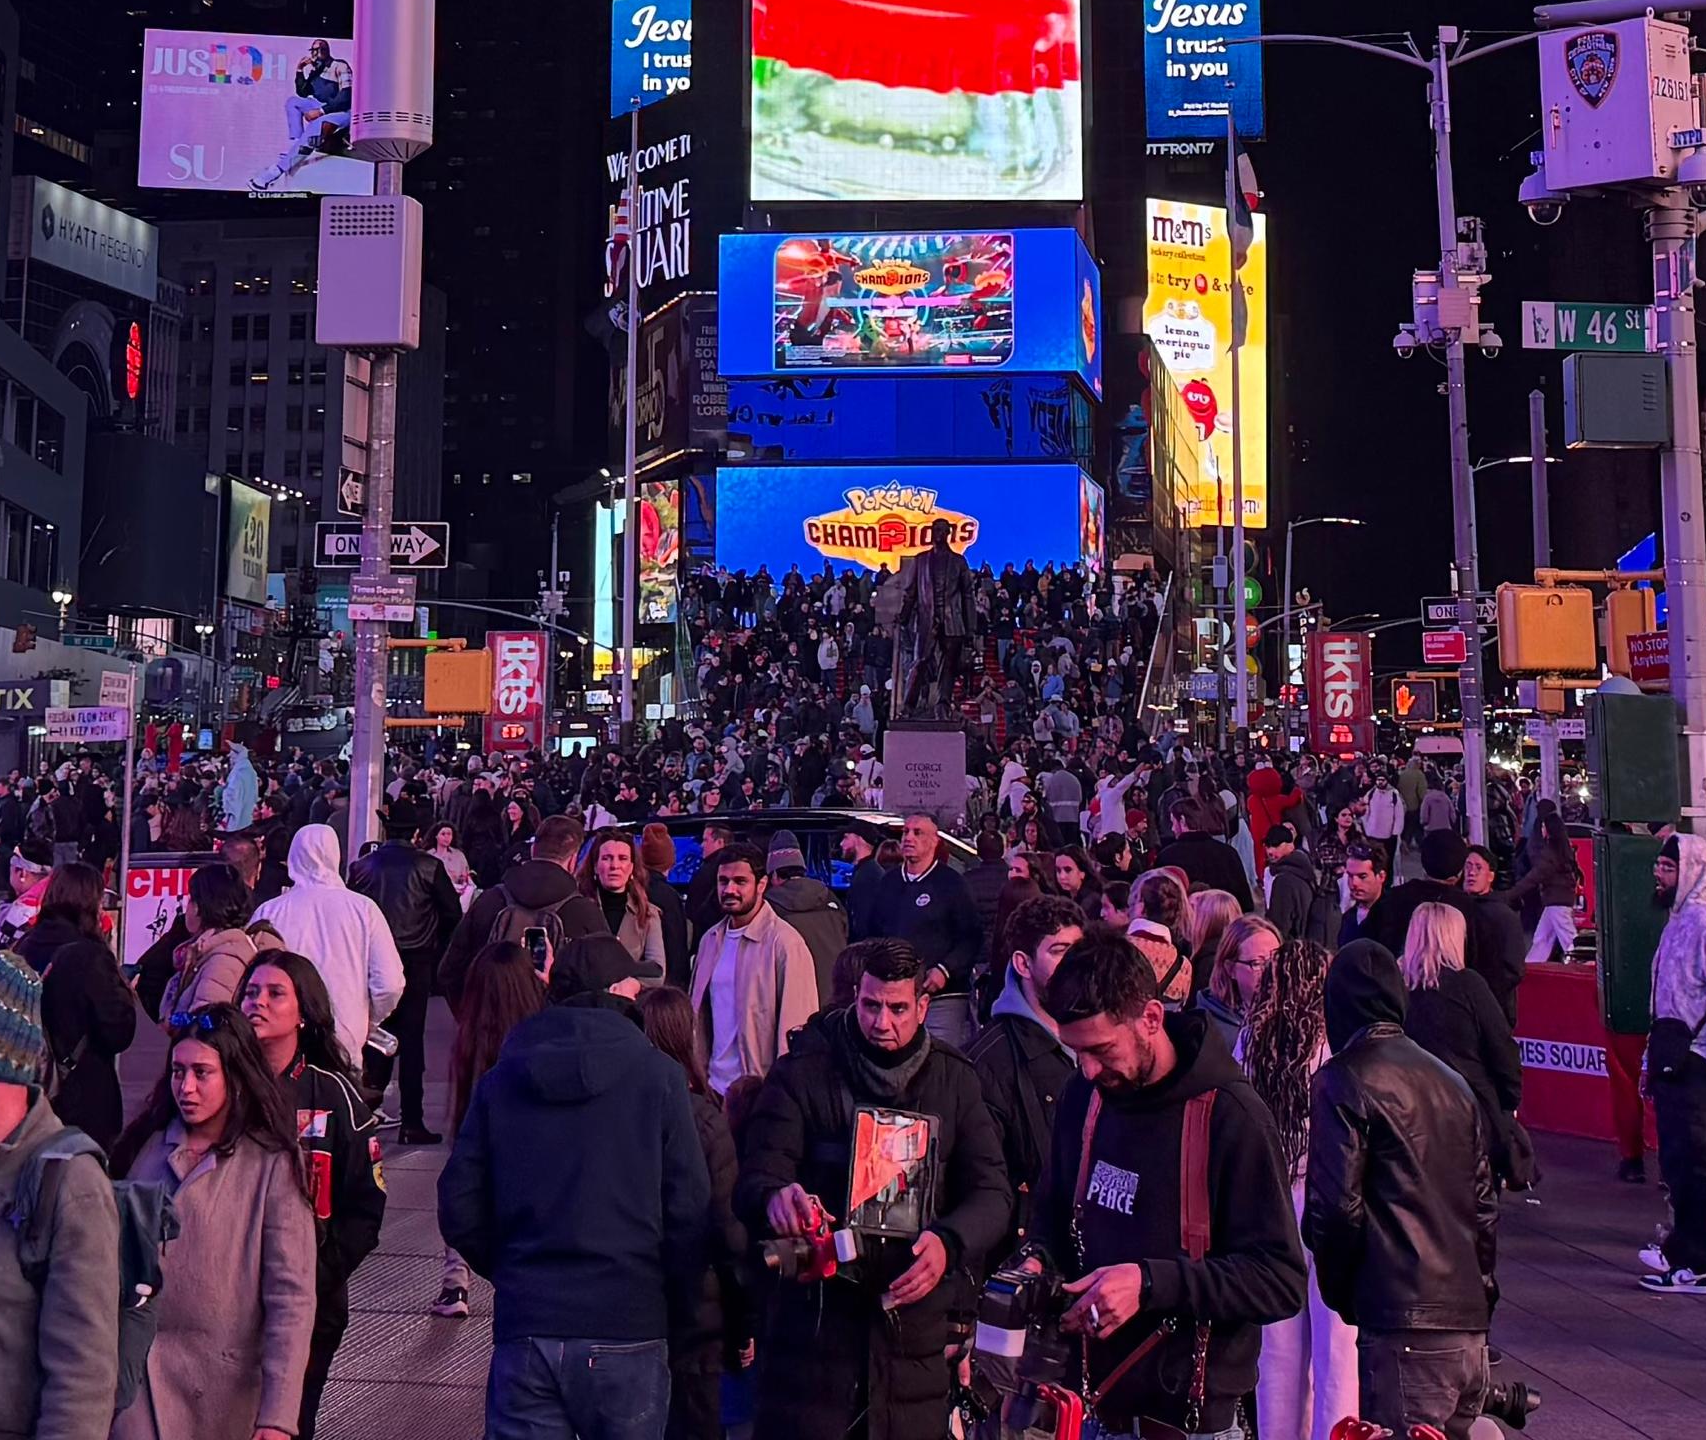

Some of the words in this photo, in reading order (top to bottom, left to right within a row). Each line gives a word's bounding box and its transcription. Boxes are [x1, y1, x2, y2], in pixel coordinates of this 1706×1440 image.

[1165, 37, 1174, 54] I
[1177, 37, 1227, 54] trust
[1165, 60, 1184, 78] in
[1188, 62, 1228, 81] you
[643, 74, 658, 91] in
[661, 77, 691, 95] yo
[1654, 75, 1690, 102] 726161
[166, 143, 225, 182] SU
[59, 218, 97, 251] HYATT
[99, 233, 150, 269] REGENCY
[1168, 273, 1191, 292] try
[1212, 277, 1222, 291] &
[1164, 324, 1200, 338] lemon
[1556, 308, 1578, 342] W
[1586, 310, 1618, 346] 46
[1625, 307, 1641, 331] St
[1155, 338, 1211, 352] meringue
[1174, 349, 1191, 361] pie
[843, 480, 938, 517] Pokémon
[353, 584, 376, 595] Times
[376, 585, 405, 595] Square
[1630, 641, 1643, 653] NO
[498, 639, 539, 715] tkts
[1323, 638, 1361, 719] tkts
[1086, 1182, 1134, 1216] PEACE
